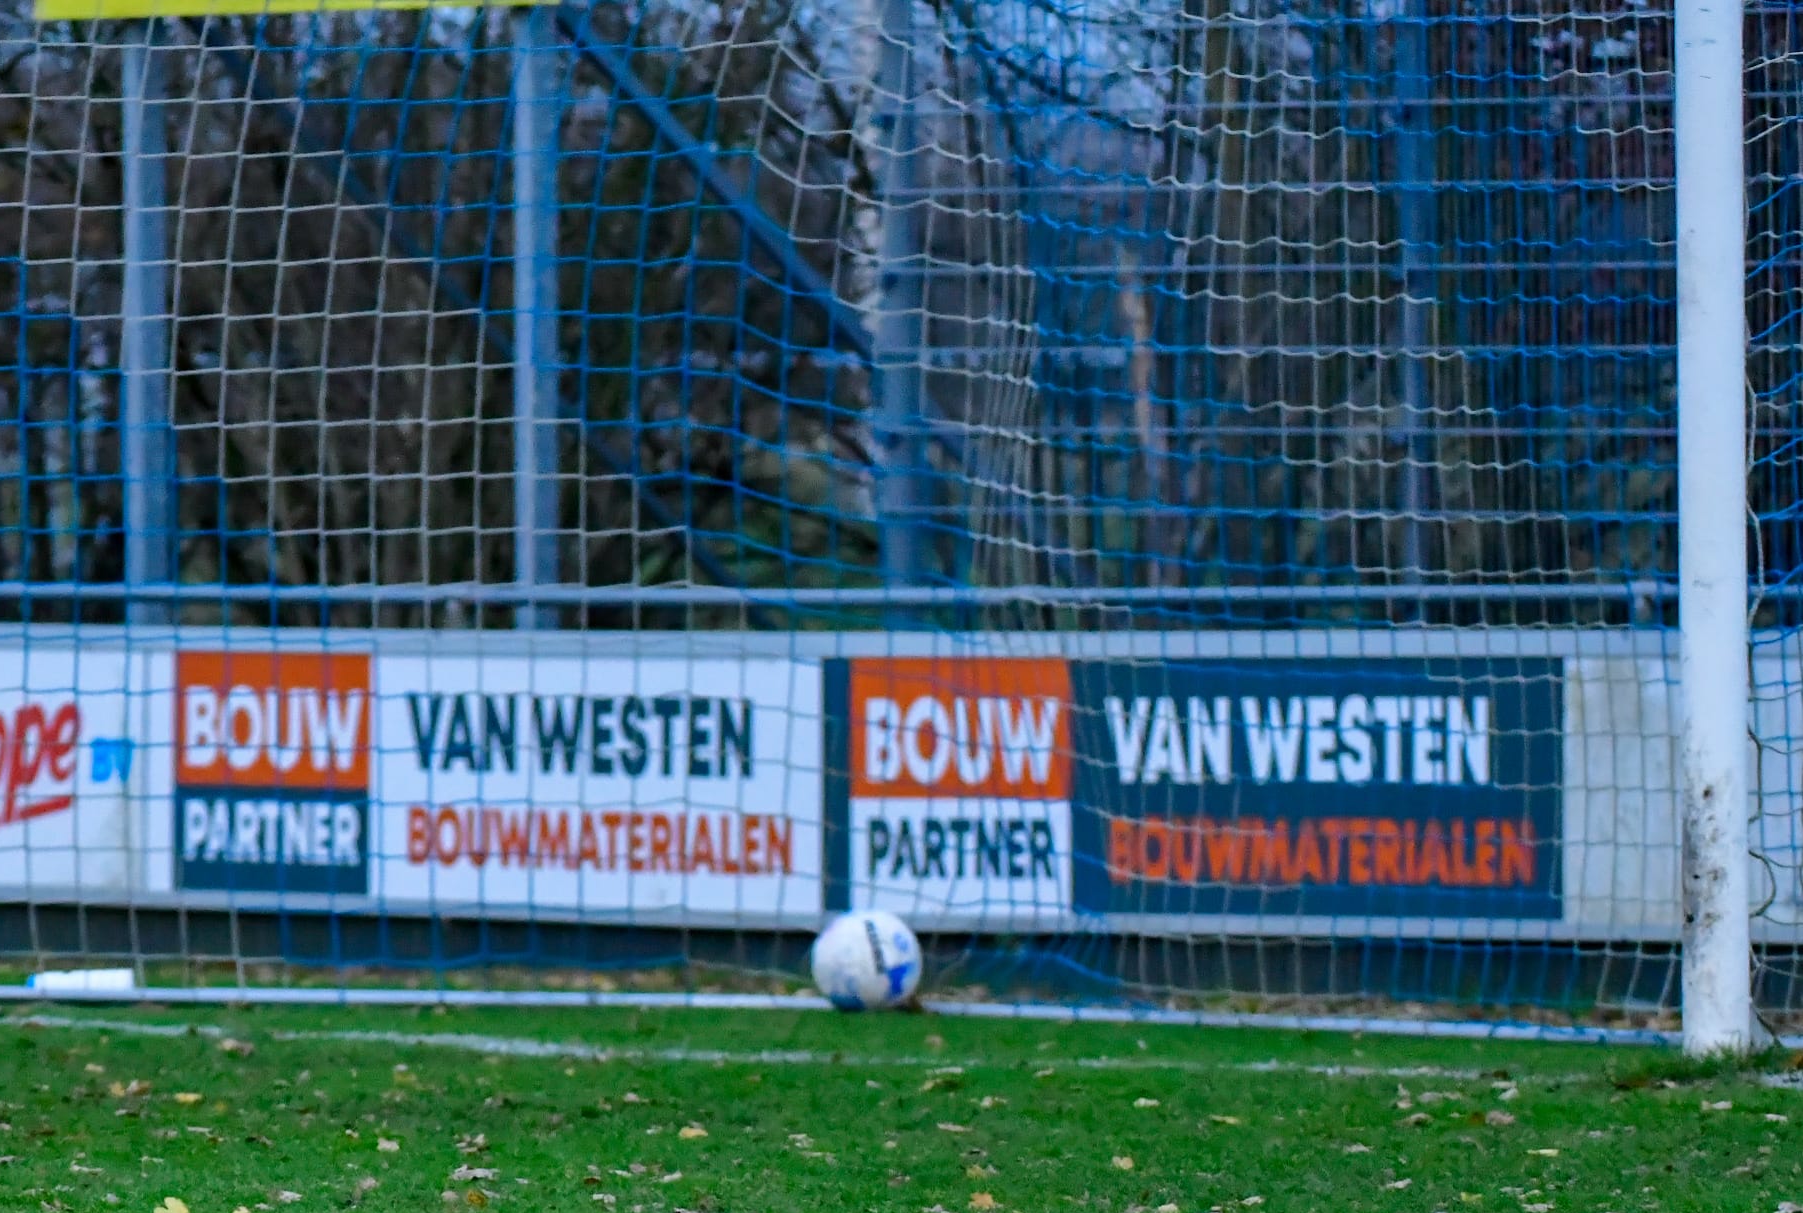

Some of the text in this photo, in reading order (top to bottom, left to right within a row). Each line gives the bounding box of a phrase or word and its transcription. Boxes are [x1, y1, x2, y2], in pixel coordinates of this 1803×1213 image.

[183, 684, 367, 772] BOUW
[405, 693, 754, 779] VAN WESTEN
[865, 695, 1061, 785] BOUW
[1103, 694, 1490, 786] VAN WESTEN
[183, 798, 361, 866] PARTNER
[406, 805, 794, 875] BOUWMATERIALEN
[868, 818, 1056, 878] PARTNER
[1108, 813, 1537, 886] BOUWMATERIALEN
